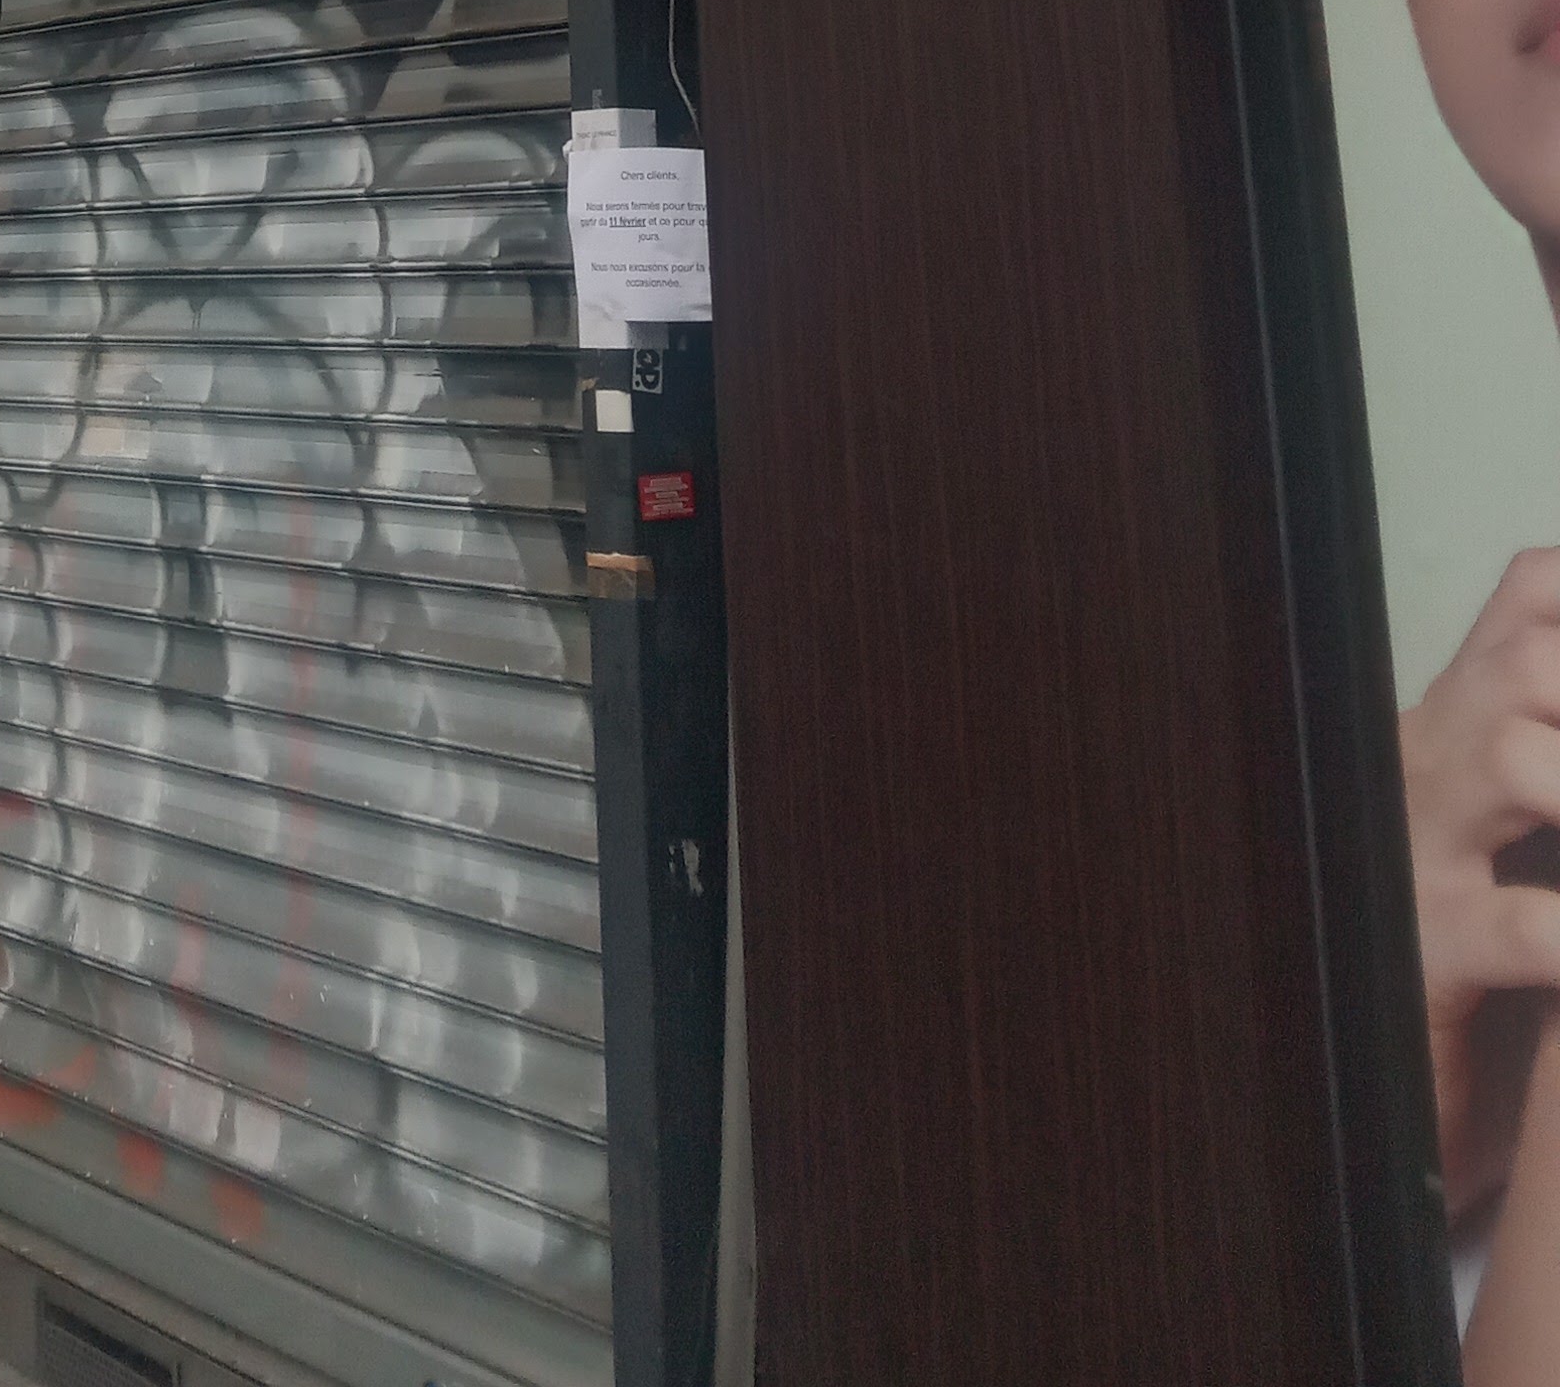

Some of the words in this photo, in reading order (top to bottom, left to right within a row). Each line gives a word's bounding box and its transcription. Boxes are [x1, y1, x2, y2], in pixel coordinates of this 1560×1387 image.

[662, 201, 685, 213] pour
[619, 216, 646, 227] février
[648, 217, 657, 226] et
[673, 217, 696, 228] pour
[671, 262, 694, 274] pour
